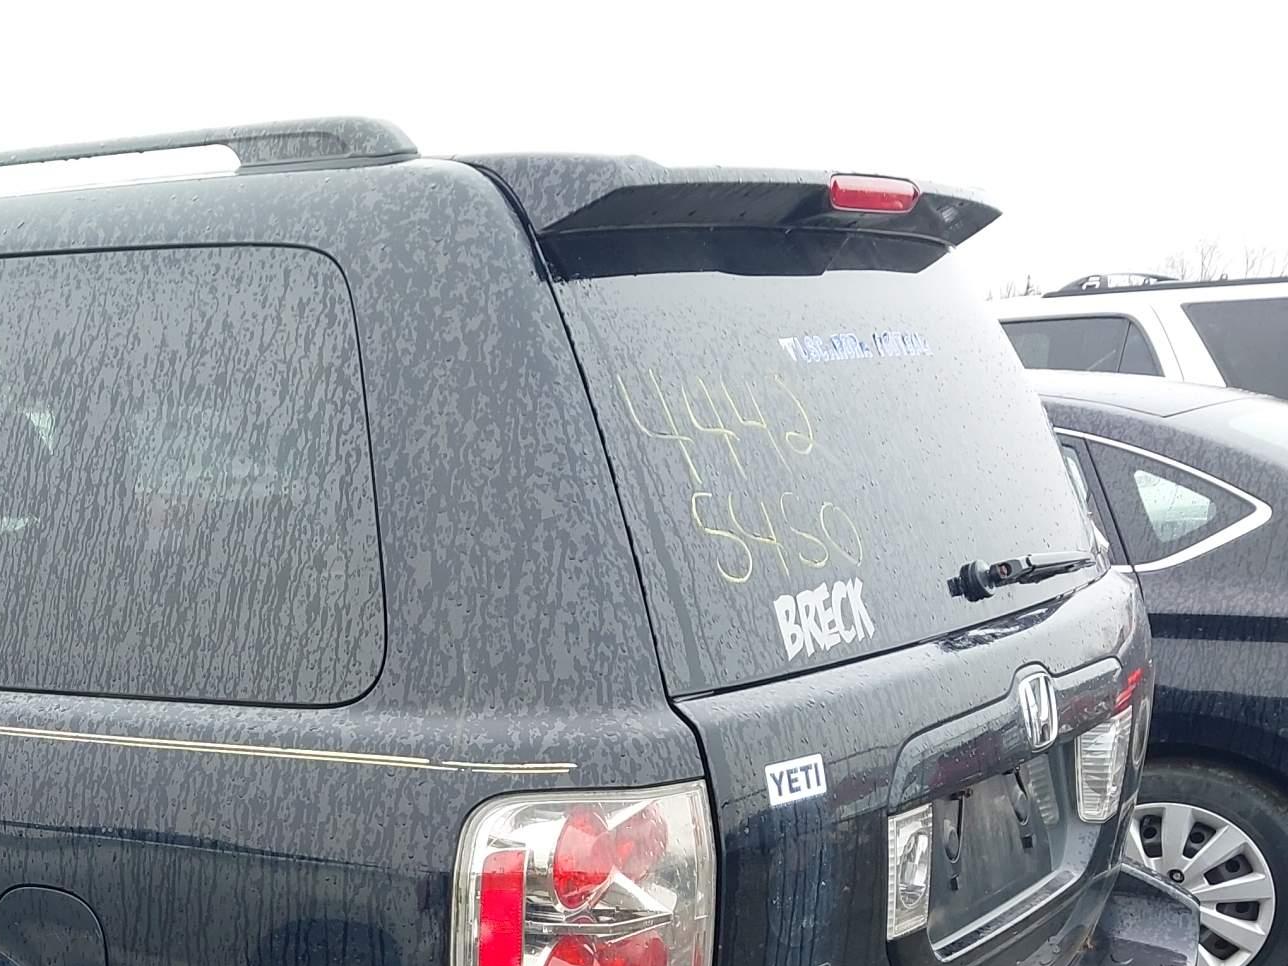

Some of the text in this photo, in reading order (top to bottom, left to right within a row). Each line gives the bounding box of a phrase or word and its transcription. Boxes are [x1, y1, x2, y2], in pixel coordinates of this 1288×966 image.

[616, 367, 813, 485] 4442
[691, 491, 863, 583] 5450
[773, 576, 875, 662] BRECK
[769, 762, 822, 797] YETI
